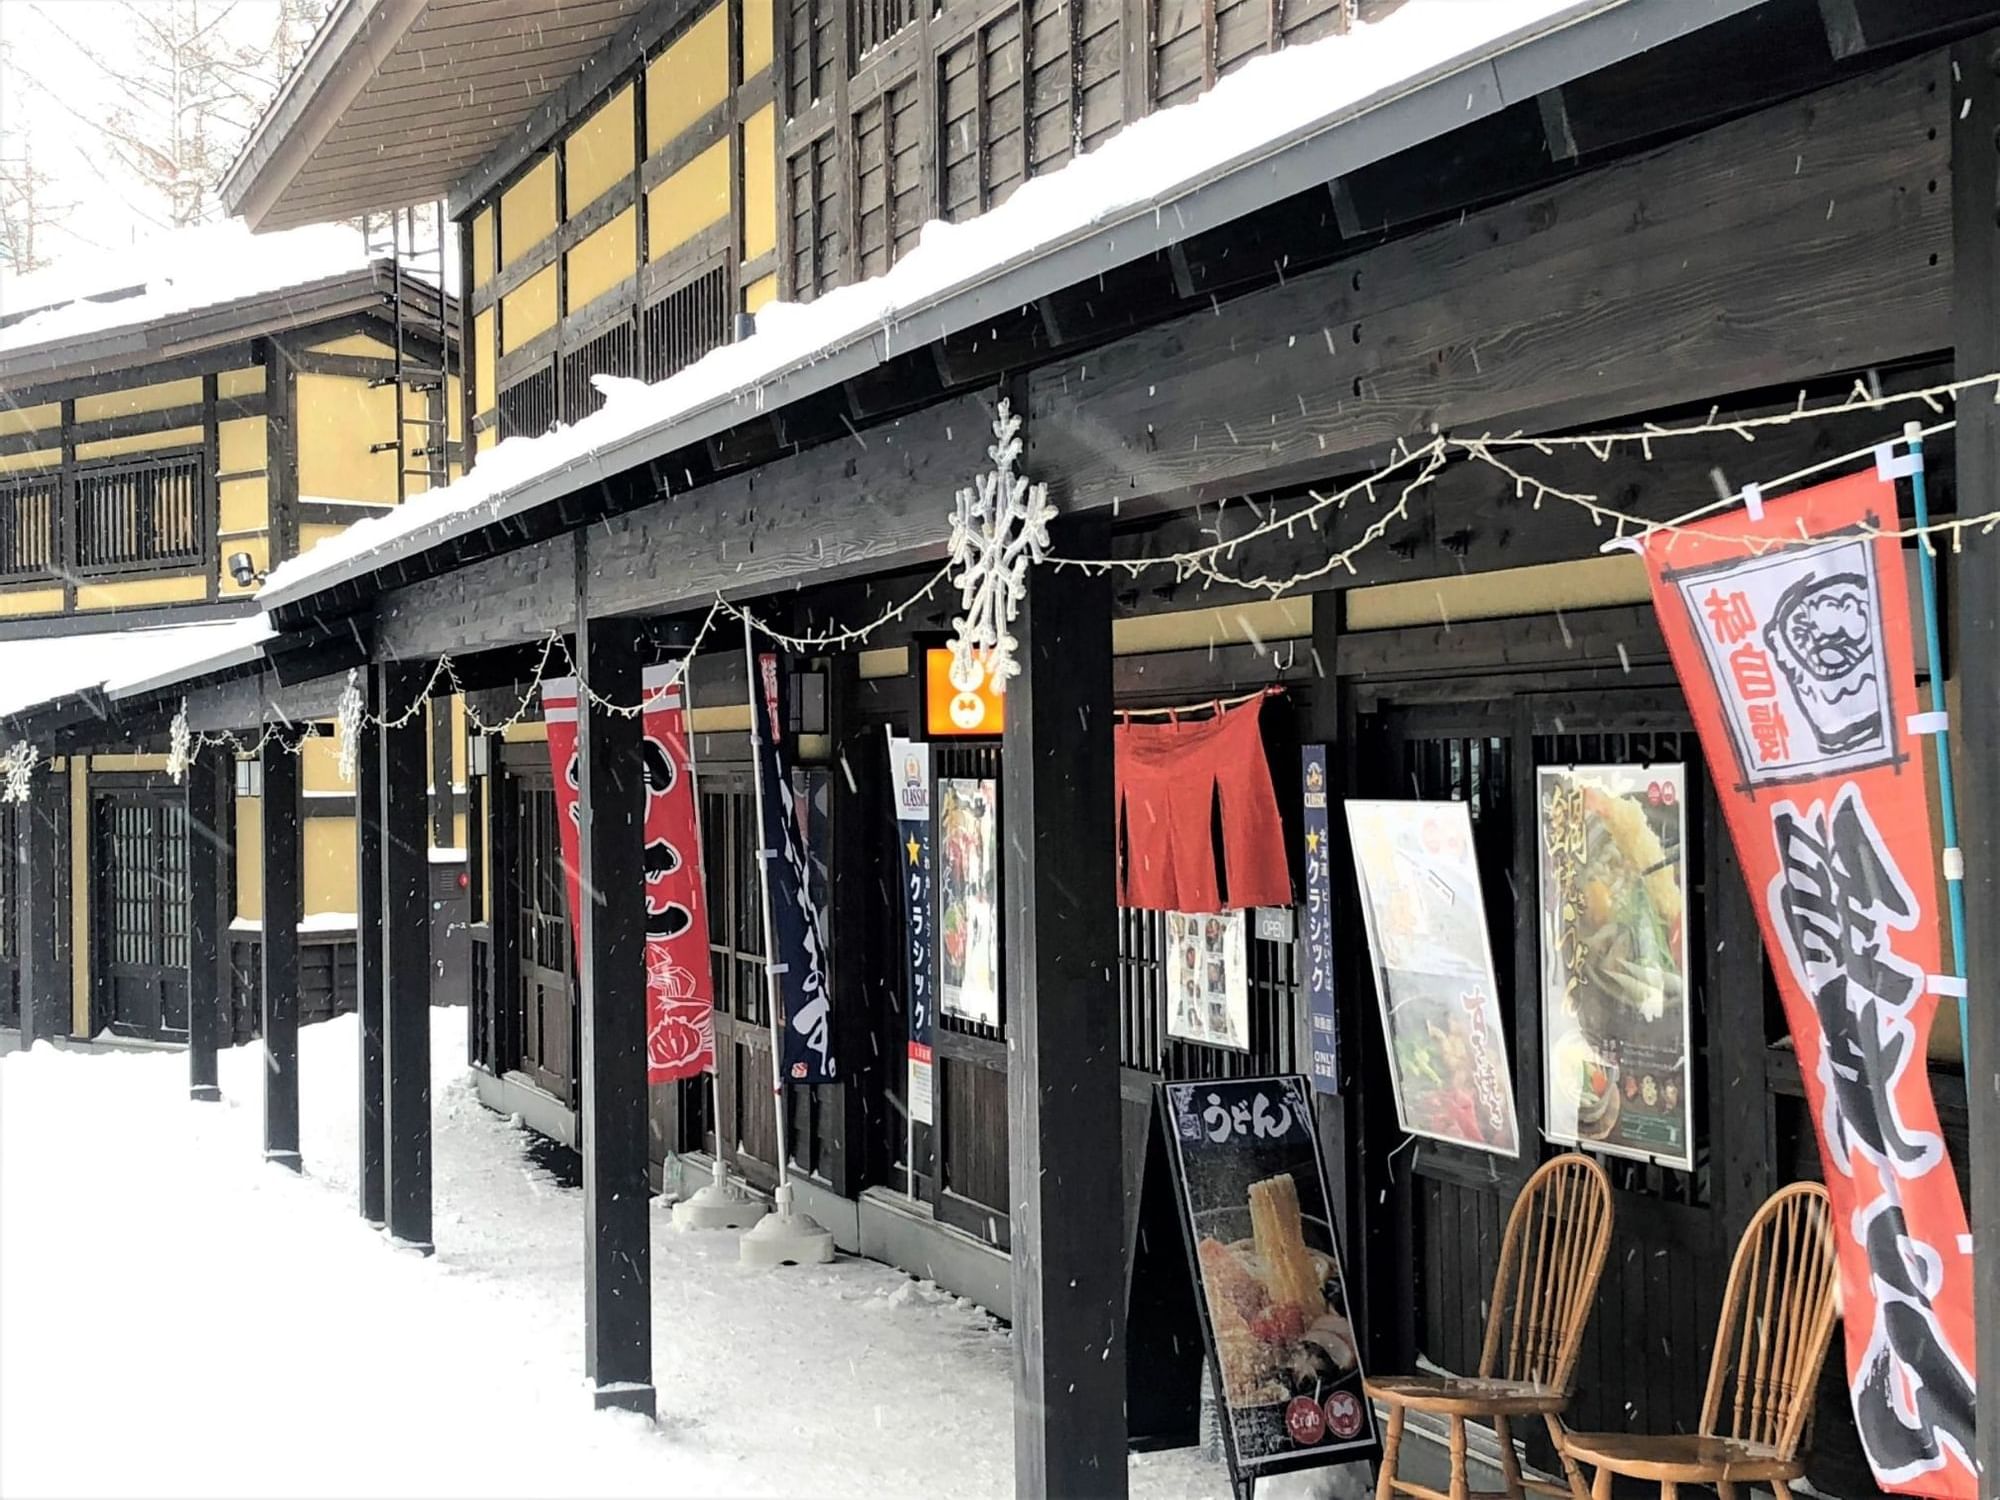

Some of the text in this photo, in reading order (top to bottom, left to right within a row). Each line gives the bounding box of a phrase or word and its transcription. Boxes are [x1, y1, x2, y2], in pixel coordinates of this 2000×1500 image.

[909, 872, 926, 1030] クラシック
[1307, 858, 1324, 993] クラシック
[1202, 1092, 1293, 1143] うどん
